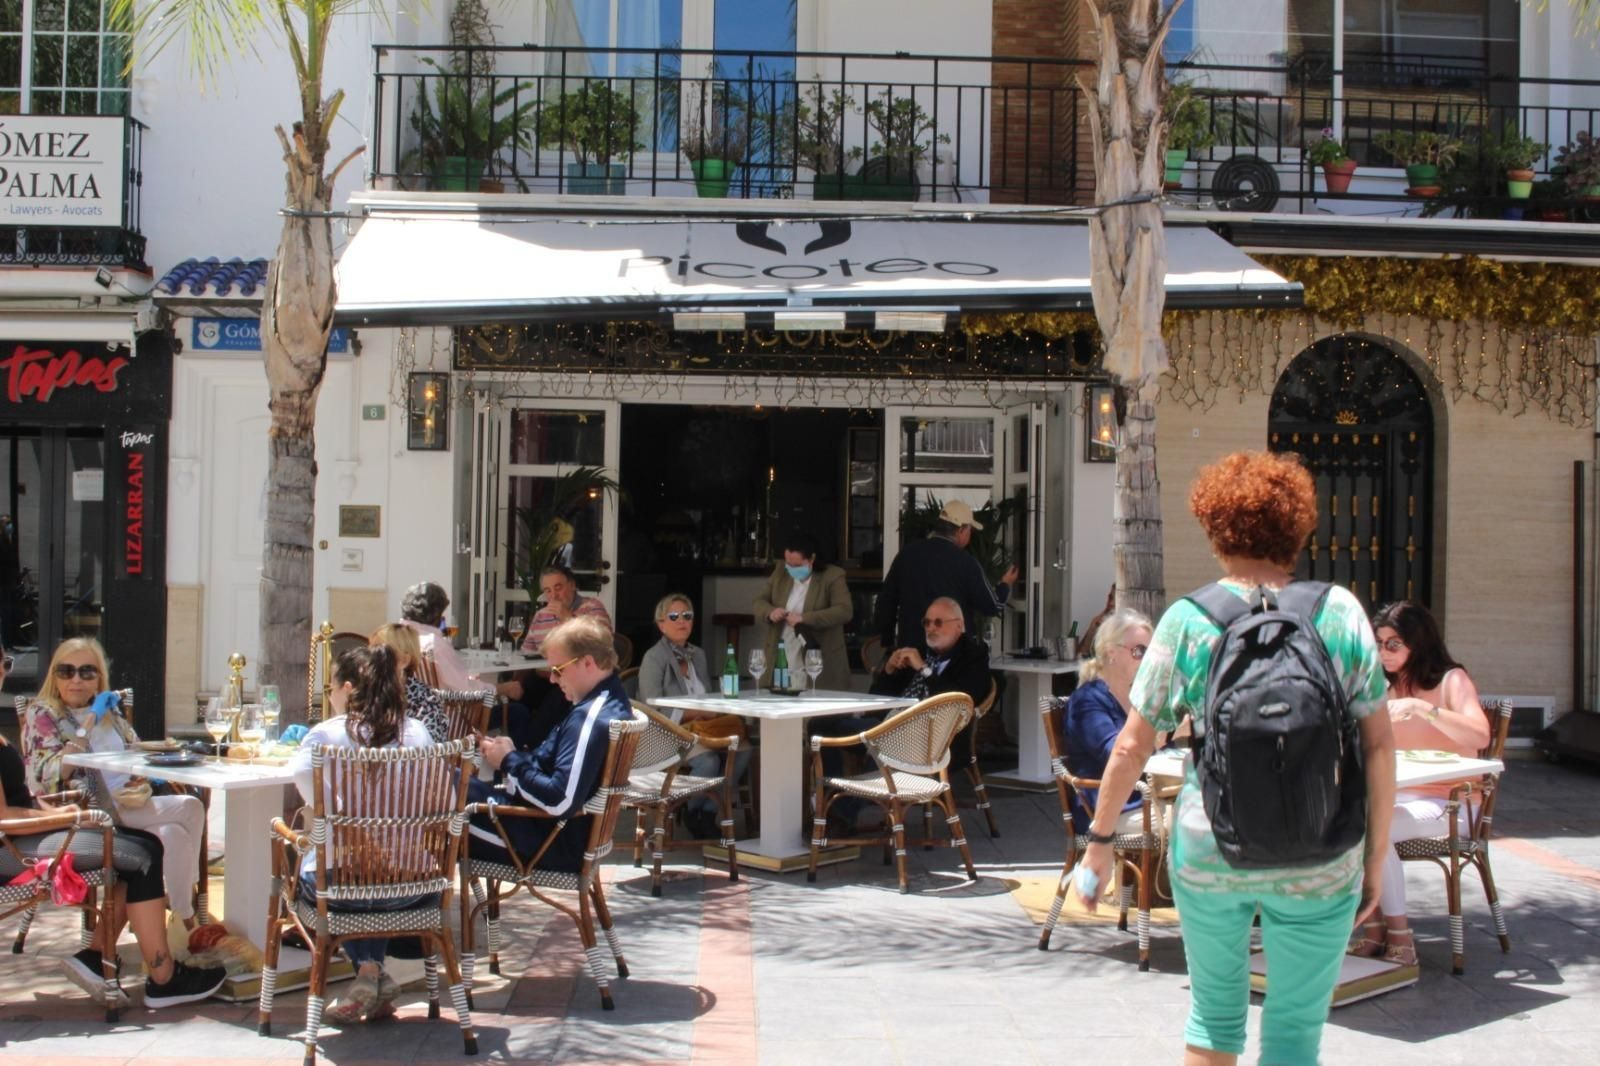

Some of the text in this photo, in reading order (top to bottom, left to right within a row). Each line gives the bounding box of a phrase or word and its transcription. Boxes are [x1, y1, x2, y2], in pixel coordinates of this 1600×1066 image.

[10, 203, 53, 217] Lawyers
[62, 203, 103, 216] Avocats
[126, 451, 145, 575] LIZARRAN
